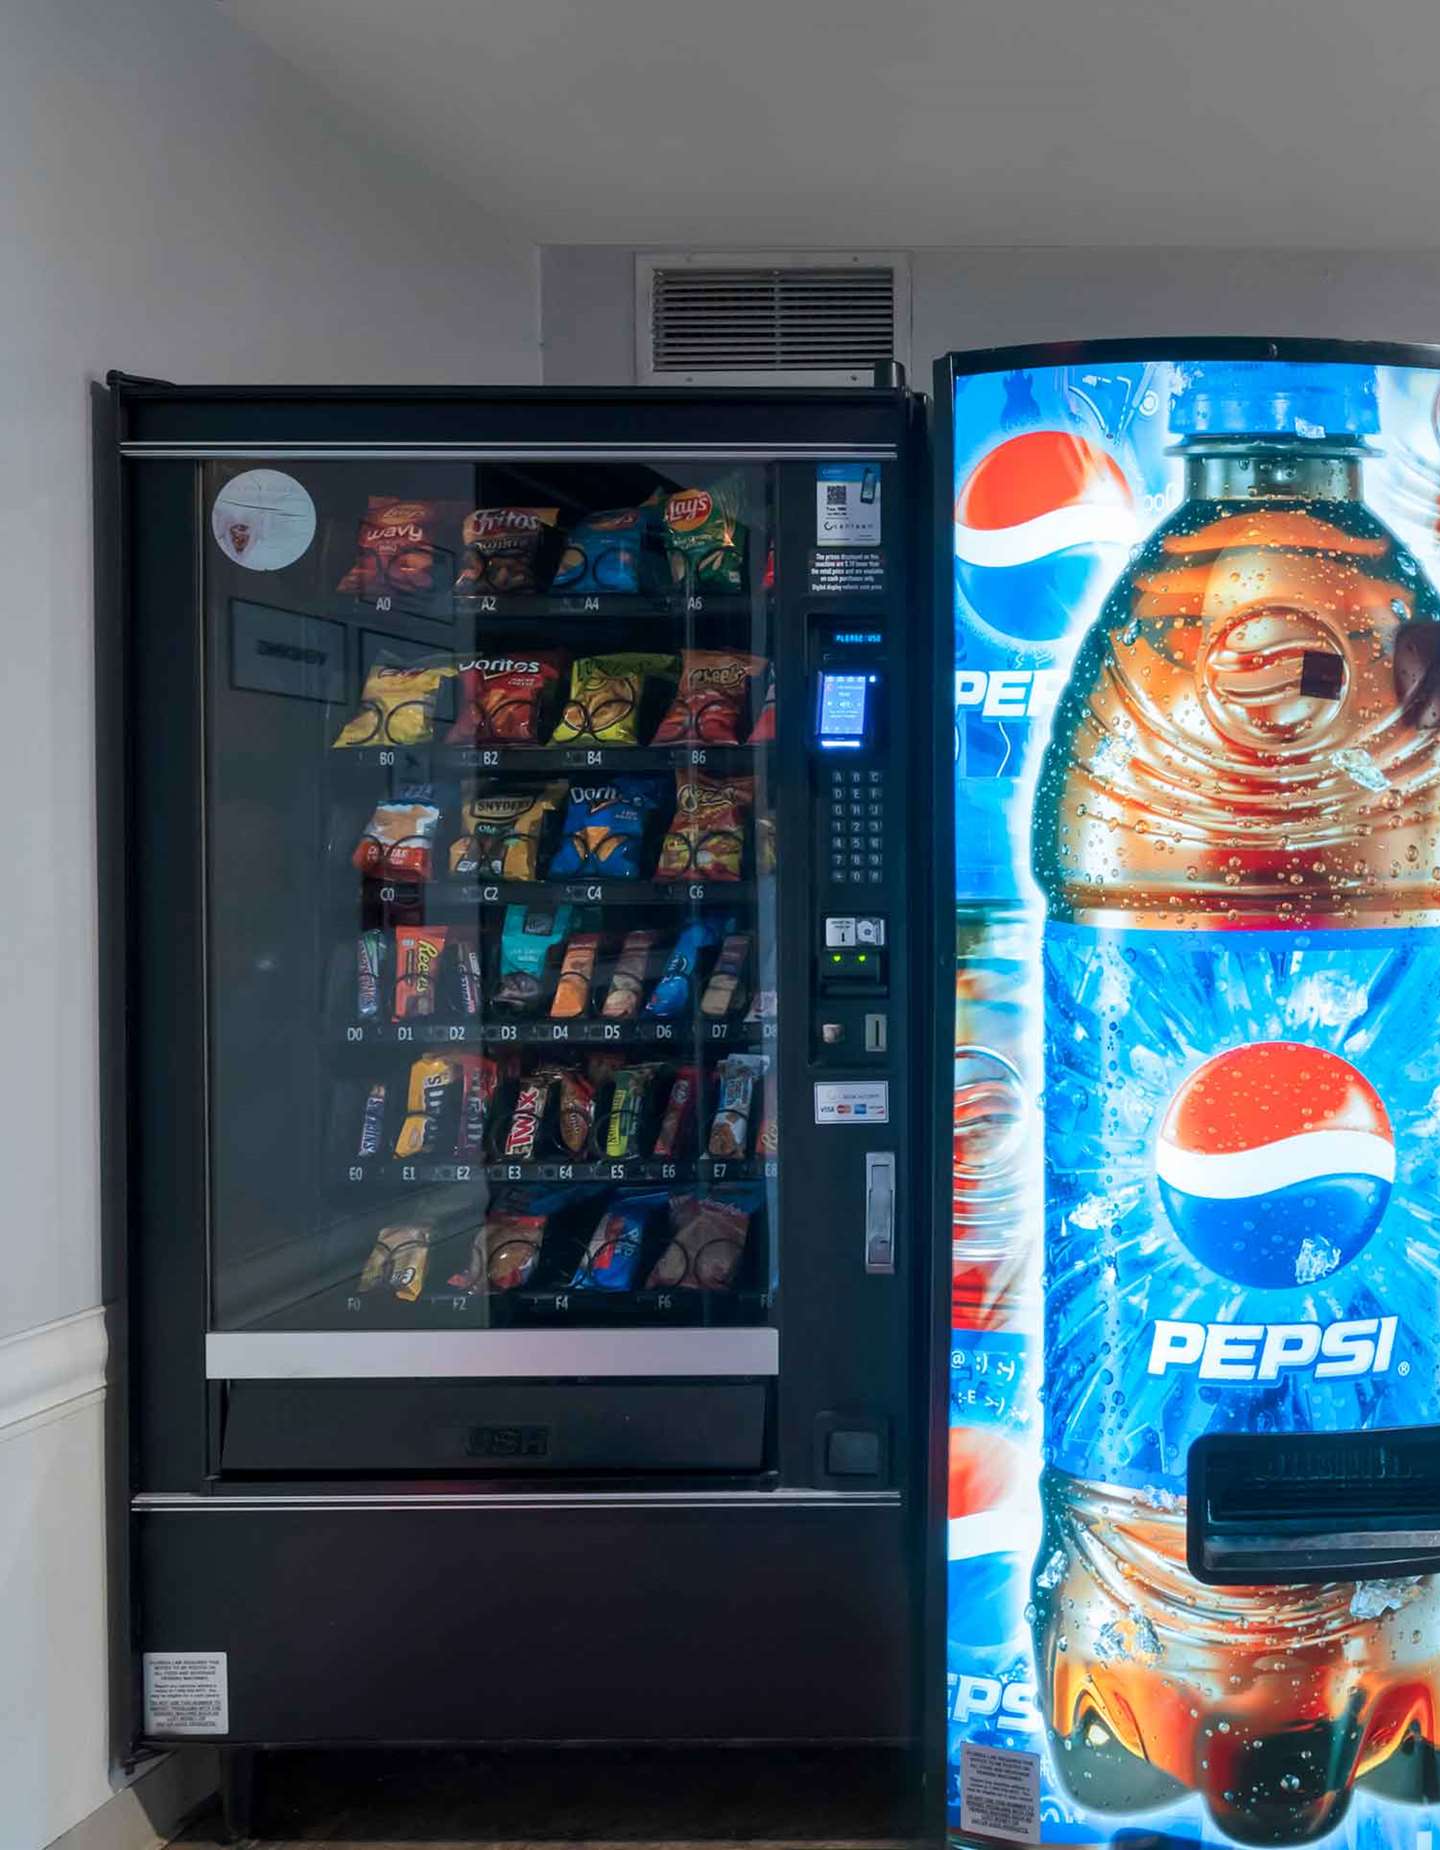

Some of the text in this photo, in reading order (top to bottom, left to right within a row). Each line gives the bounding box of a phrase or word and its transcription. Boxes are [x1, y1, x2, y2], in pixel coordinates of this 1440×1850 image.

[473, 508, 540, 536] Fritos
[367, 522, 424, 542] wavy
[376, 598, 391, 611] A0
[482, 598, 496, 610] A2
[584, 598, 599, 610] A4
[687, 598, 702, 610] A6
[380, 752, 394, 765] B0
[484, 752, 498, 765] B2
[587, 751, 602, 765] B4
[692, 750, 706, 764] B6
[380, 887, 394, 901] C0
[484, 887, 499, 901] C2
[587, 886, 602, 900] C4
[689, 885, 704, 899] C6
[347, 1027, 363, 1041] D0
[398, 1027, 413, 1041] D1
[450, 1027, 465, 1040] D2
[501, 1026, 517, 1040] D3
[553, 1025, 568, 1040] D4
[604, 1025, 620, 1039] D5
[656, 1025, 672, 1039] D6
[712, 1024, 728, 1038] D7
[350, 1167, 363, 1181] E0
[403, 1167, 415, 1180] E1
[457, 1166, 470, 1180] E2
[508, 1166, 521, 1179] E3
[559, 1165, 573, 1179] E4
[611, 1165, 624, 1179] E5
[662, 1164, 676, 1178] E6
[714, 1164, 727, 1177] E7
[453, 1298, 467, 1311] F2
[555, 1297, 569, 1311] F4
[658, 1297, 672, 1311] F6
[1148, 1316, 1398, 1381] PEPSI
